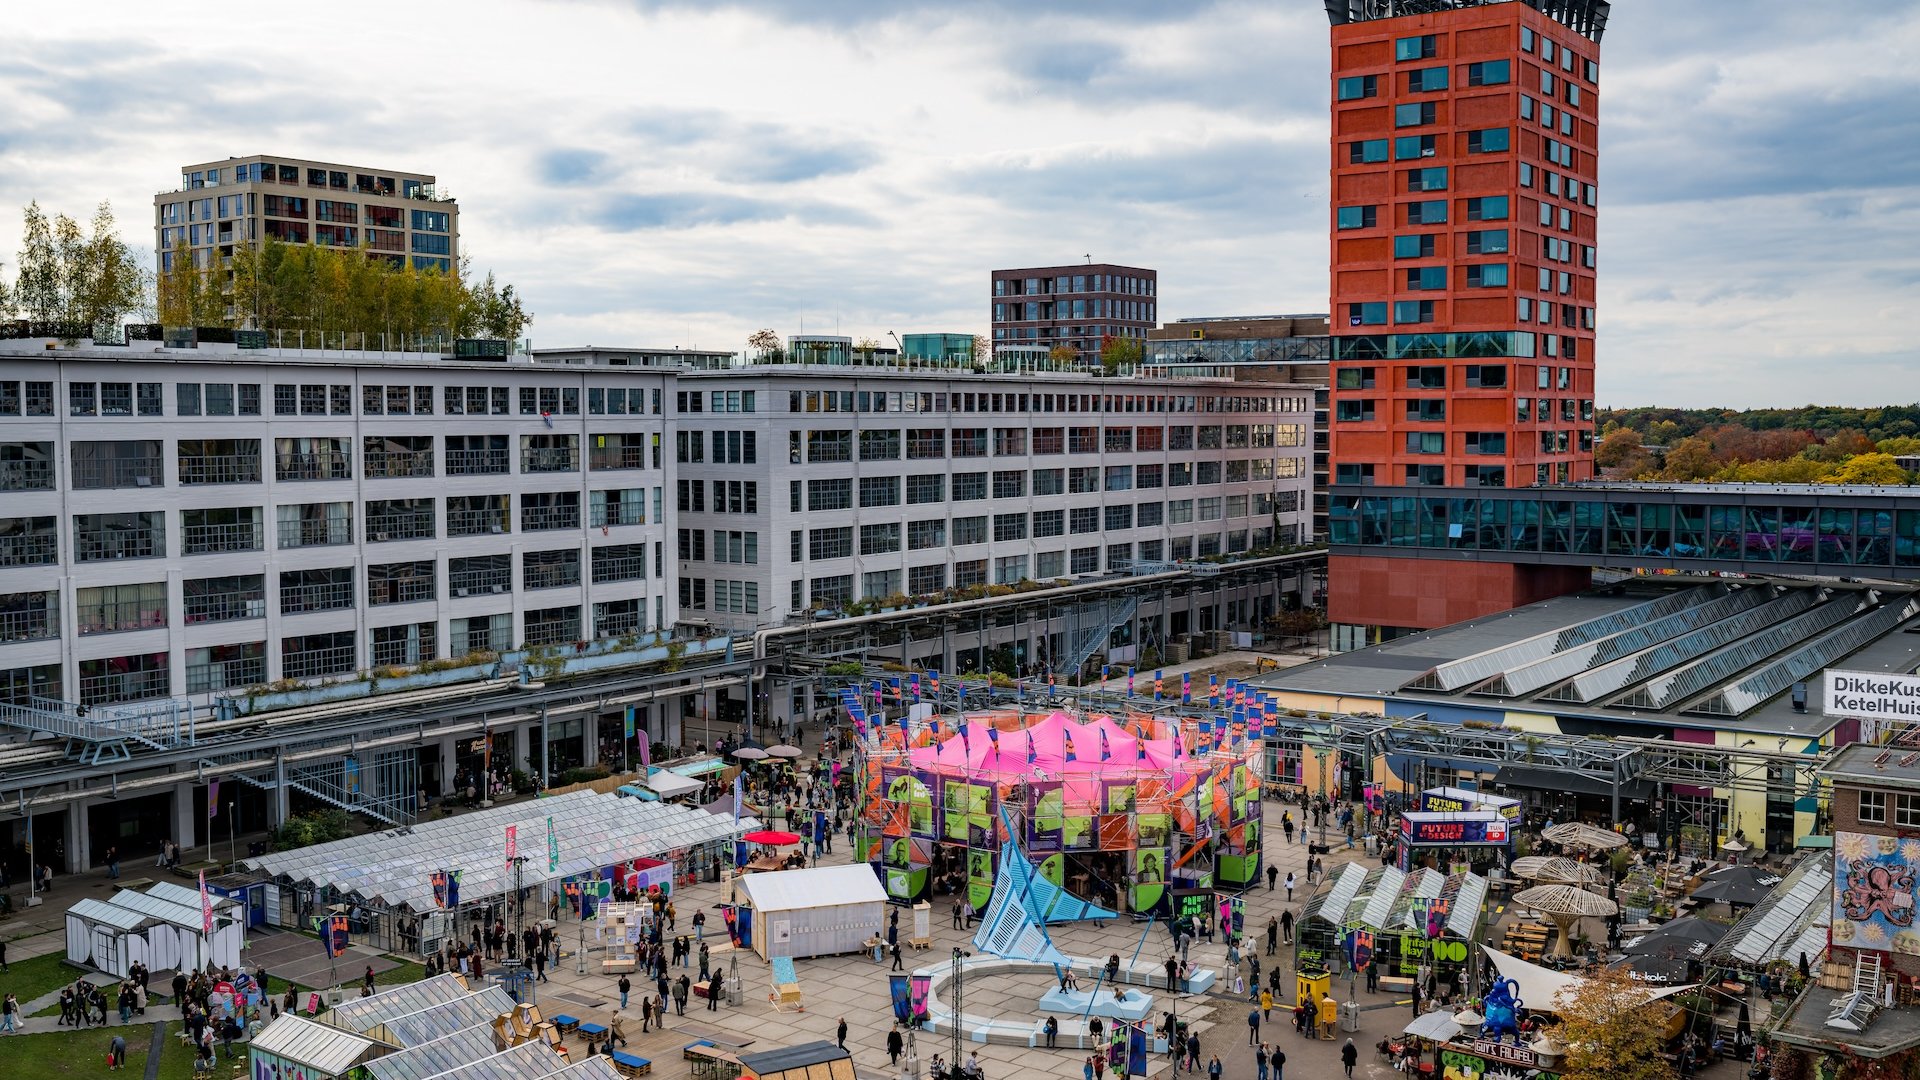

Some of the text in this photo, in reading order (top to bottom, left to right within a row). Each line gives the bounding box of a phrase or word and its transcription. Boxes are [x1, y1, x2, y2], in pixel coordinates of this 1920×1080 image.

[1428, 797, 1463, 811] FUTURE
[1421, 824, 1465, 833] FUTURE
[1476, 1042, 1533, 1062] GUY'S FALAFEL
